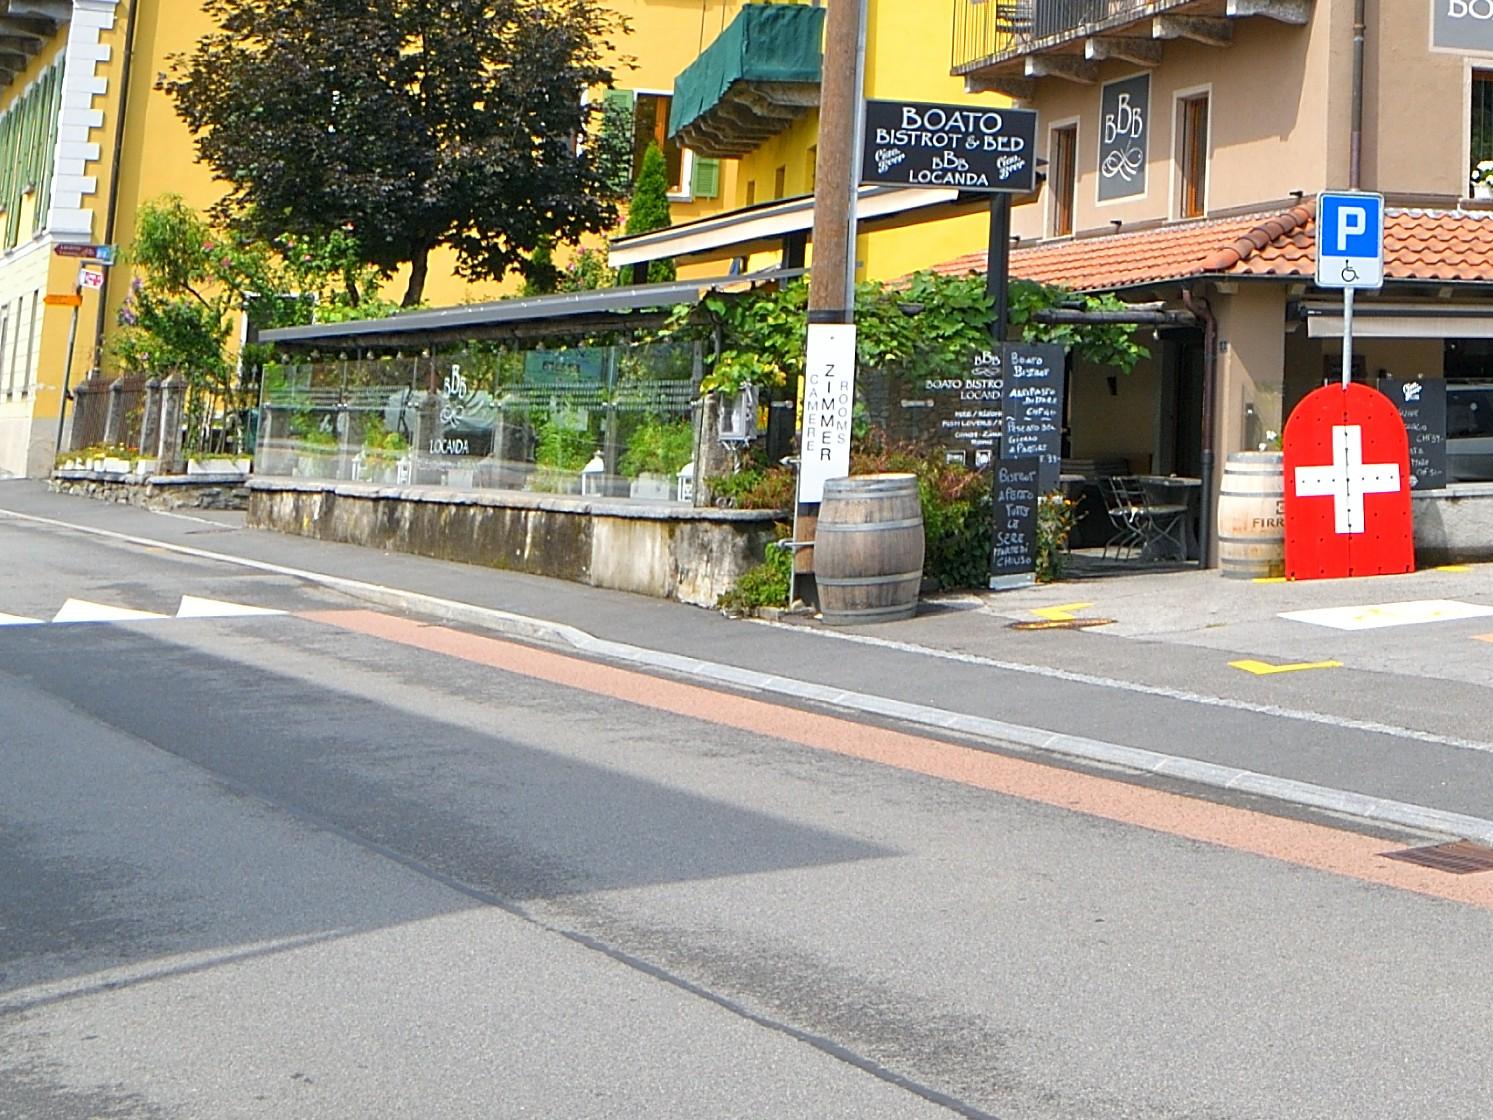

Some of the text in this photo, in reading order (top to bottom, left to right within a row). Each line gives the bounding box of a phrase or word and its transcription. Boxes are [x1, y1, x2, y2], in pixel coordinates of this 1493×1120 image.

[901, 106, 1002, 134] BOATO
[1104, 93, 1143, 144] BBB
[876, 128, 1025, 152] BISTROT & BED
[932, 150, 969, 171] BBB
[909, 169, 989, 186] LOCANDA
[1337, 206, 1366, 251] P
[926, 380, 1004, 389] BOATO BISTRO
[960, 391, 1001, 400] LOCAND
[806, 374, 819, 451] CAMERE
[820, 364, 835, 461] ZIMMER
[836, 380, 849, 444] ROOMS
[1252, 517, 1284, 528] FIRR
